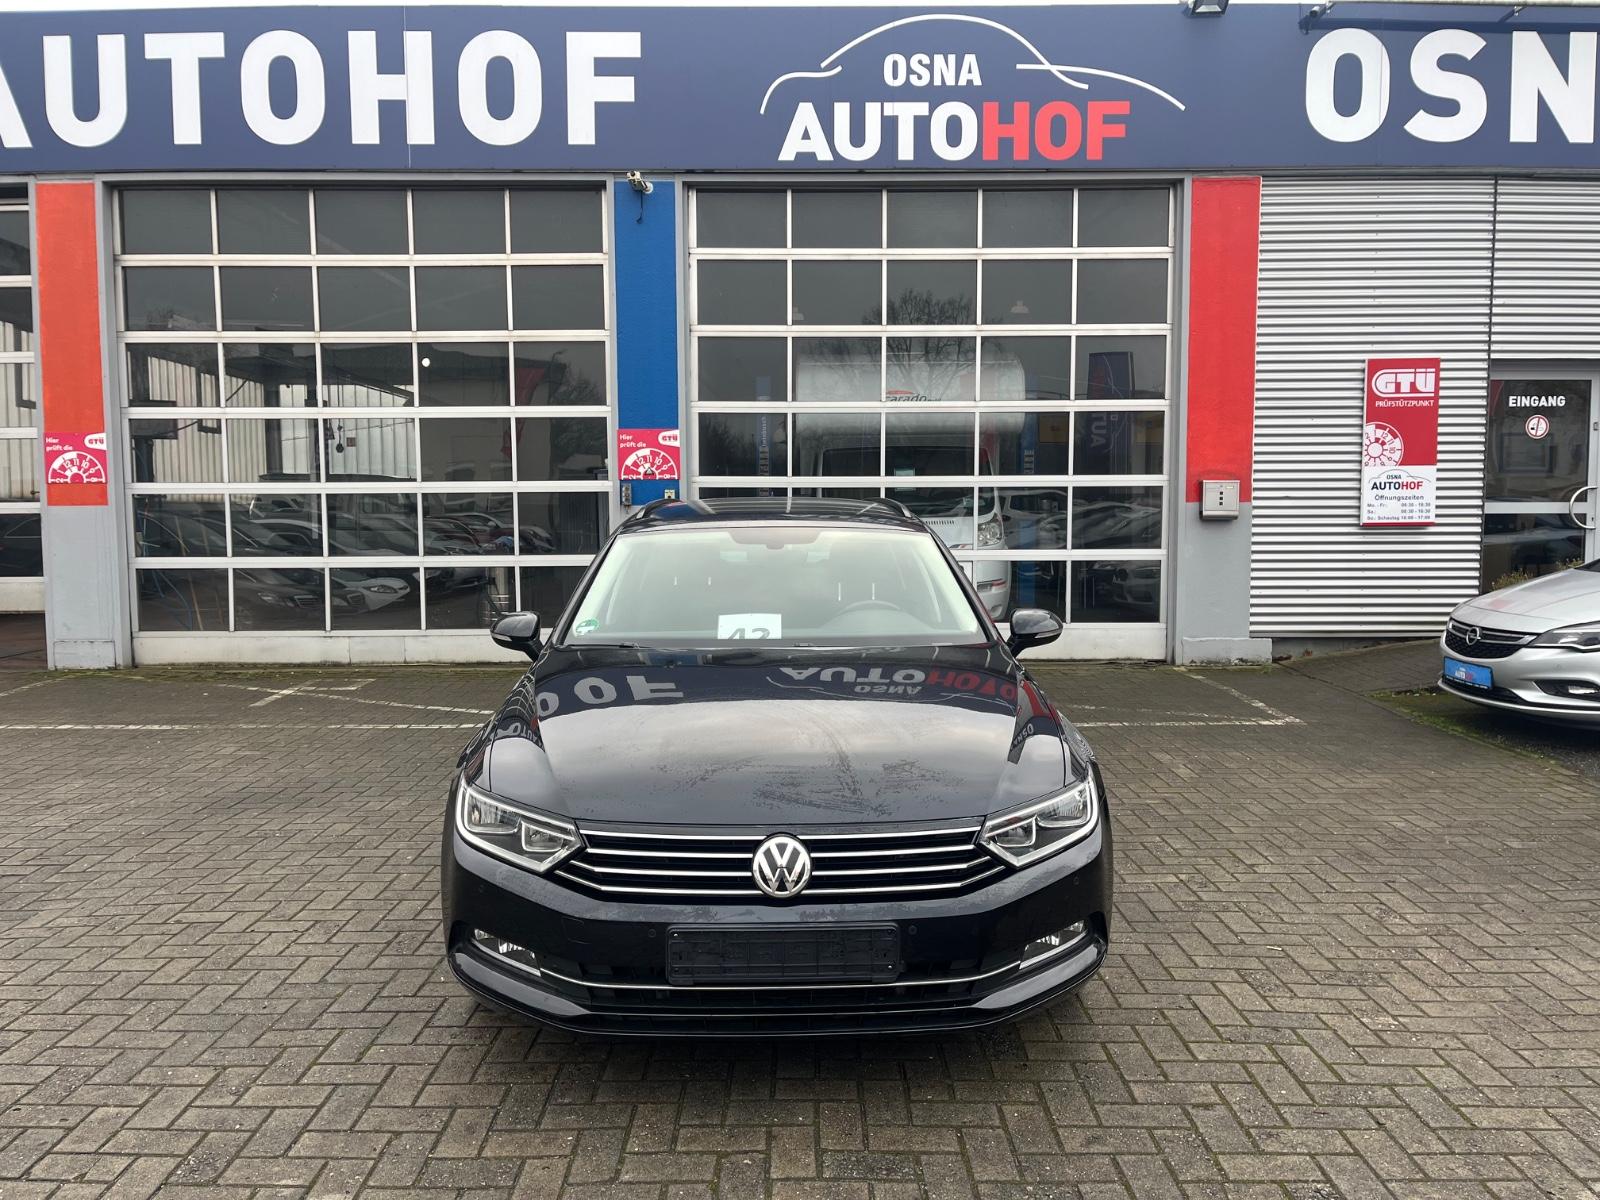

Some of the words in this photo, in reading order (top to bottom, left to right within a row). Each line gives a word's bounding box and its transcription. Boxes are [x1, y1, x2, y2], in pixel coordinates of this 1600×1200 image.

[882, 53, 982, 88] OSNA
[1304, 28, 1598, 144] OSN
[778, 100, 1131, 162] AUTOHOF
[1371, 368, 1436, 397] GTÜ
[1375, 399, 1435, 408] PRÜFSTÜTZPUNKT
[1508, 395, 1566, 407] EINGANG
[88, 437, 104, 445] GTÜ
[619, 441, 637, 449] prüft
[45, 445, 63, 453] prüft
[1371, 481, 1424, 490] AUTOHOF
